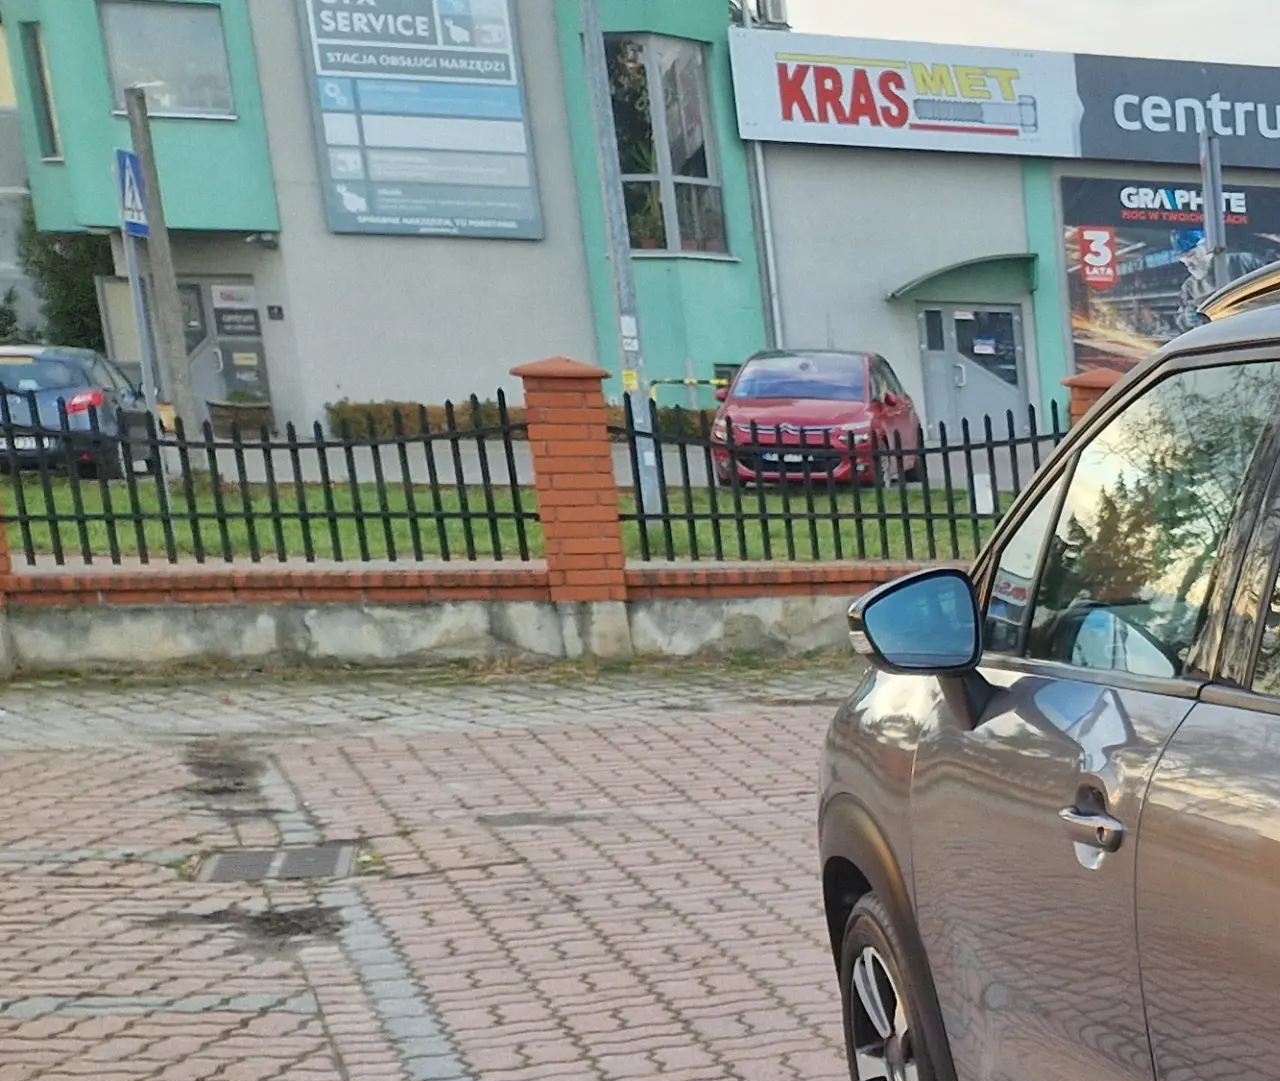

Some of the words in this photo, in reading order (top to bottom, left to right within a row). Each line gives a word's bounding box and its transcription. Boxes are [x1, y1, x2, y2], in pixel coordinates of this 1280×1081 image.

[319, 10, 430, 37] SERVICE
[326, 52, 378, 66] STACJA
[379, 55, 437, 68] OBSŁUGI
[440, 57, 506, 73] NARZĘDZI
[1119, 186, 1247, 214] GRAPHTE
[1083, 230, 1113, 266] 3
[1085, 265, 1115, 276] LATA
